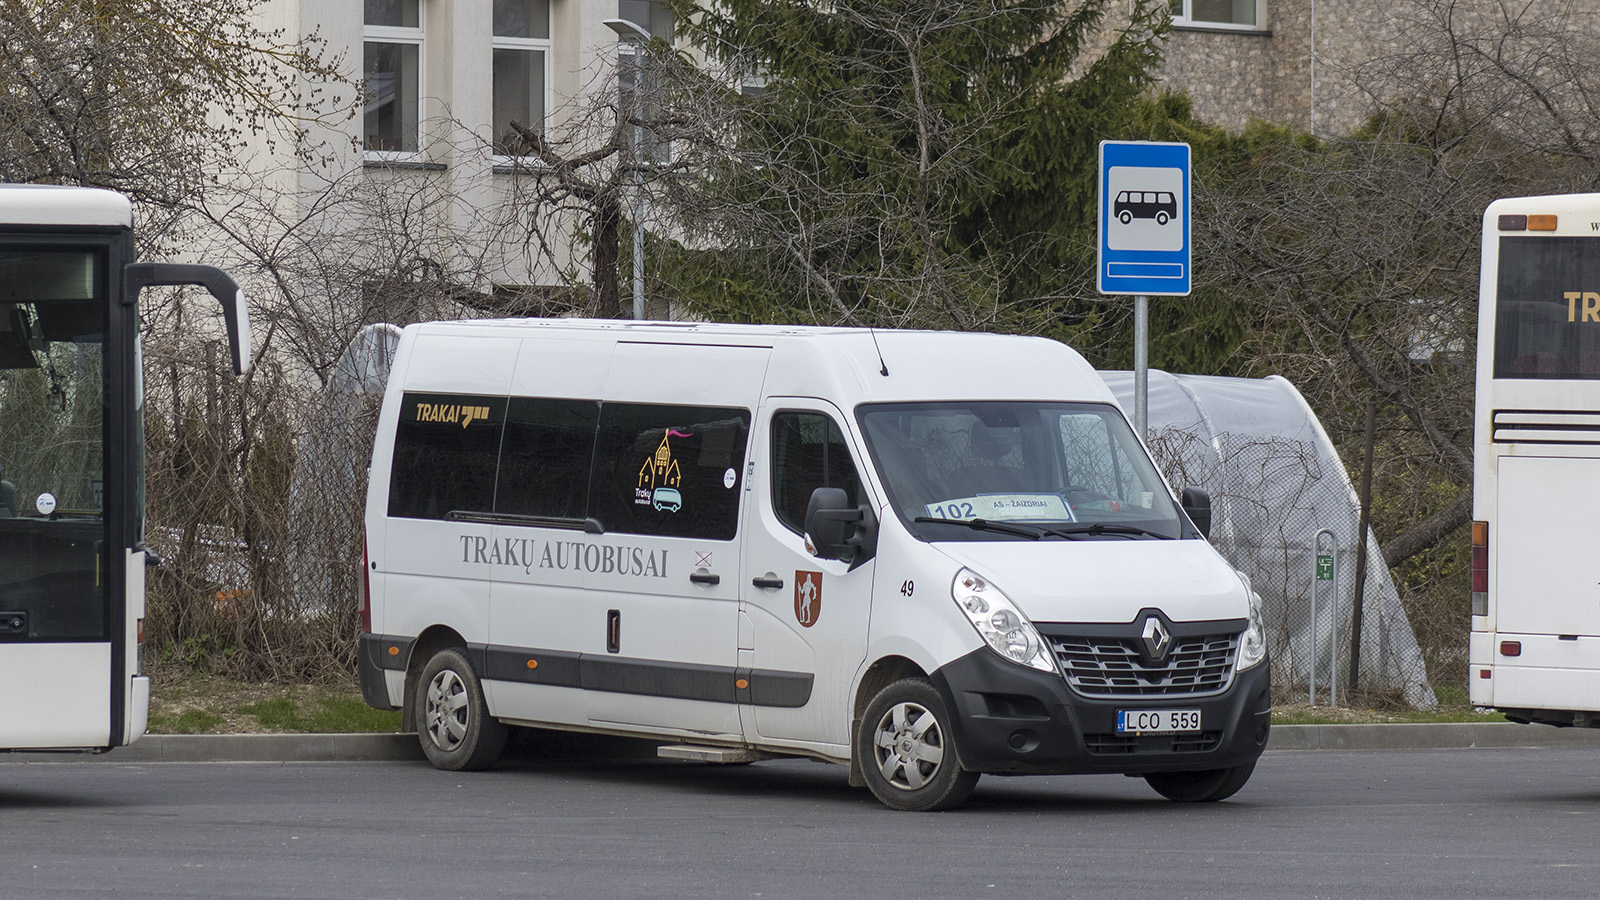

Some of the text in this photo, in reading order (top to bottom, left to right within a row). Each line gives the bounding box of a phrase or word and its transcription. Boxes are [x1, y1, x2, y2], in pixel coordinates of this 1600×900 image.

[1563, 291, 1600, 323] TR
[416, 403, 461, 423] TRAKAI
[934, 502, 977, 520] 102
[993, 501, 1005, 509] AS
[459, 535, 669, 578] TRAKŲ AUTOBUSAI
[900, 580, 914, 597] 49
[1127, 712, 1160, 730] LCO
[1170, 712, 1199, 729] 559
